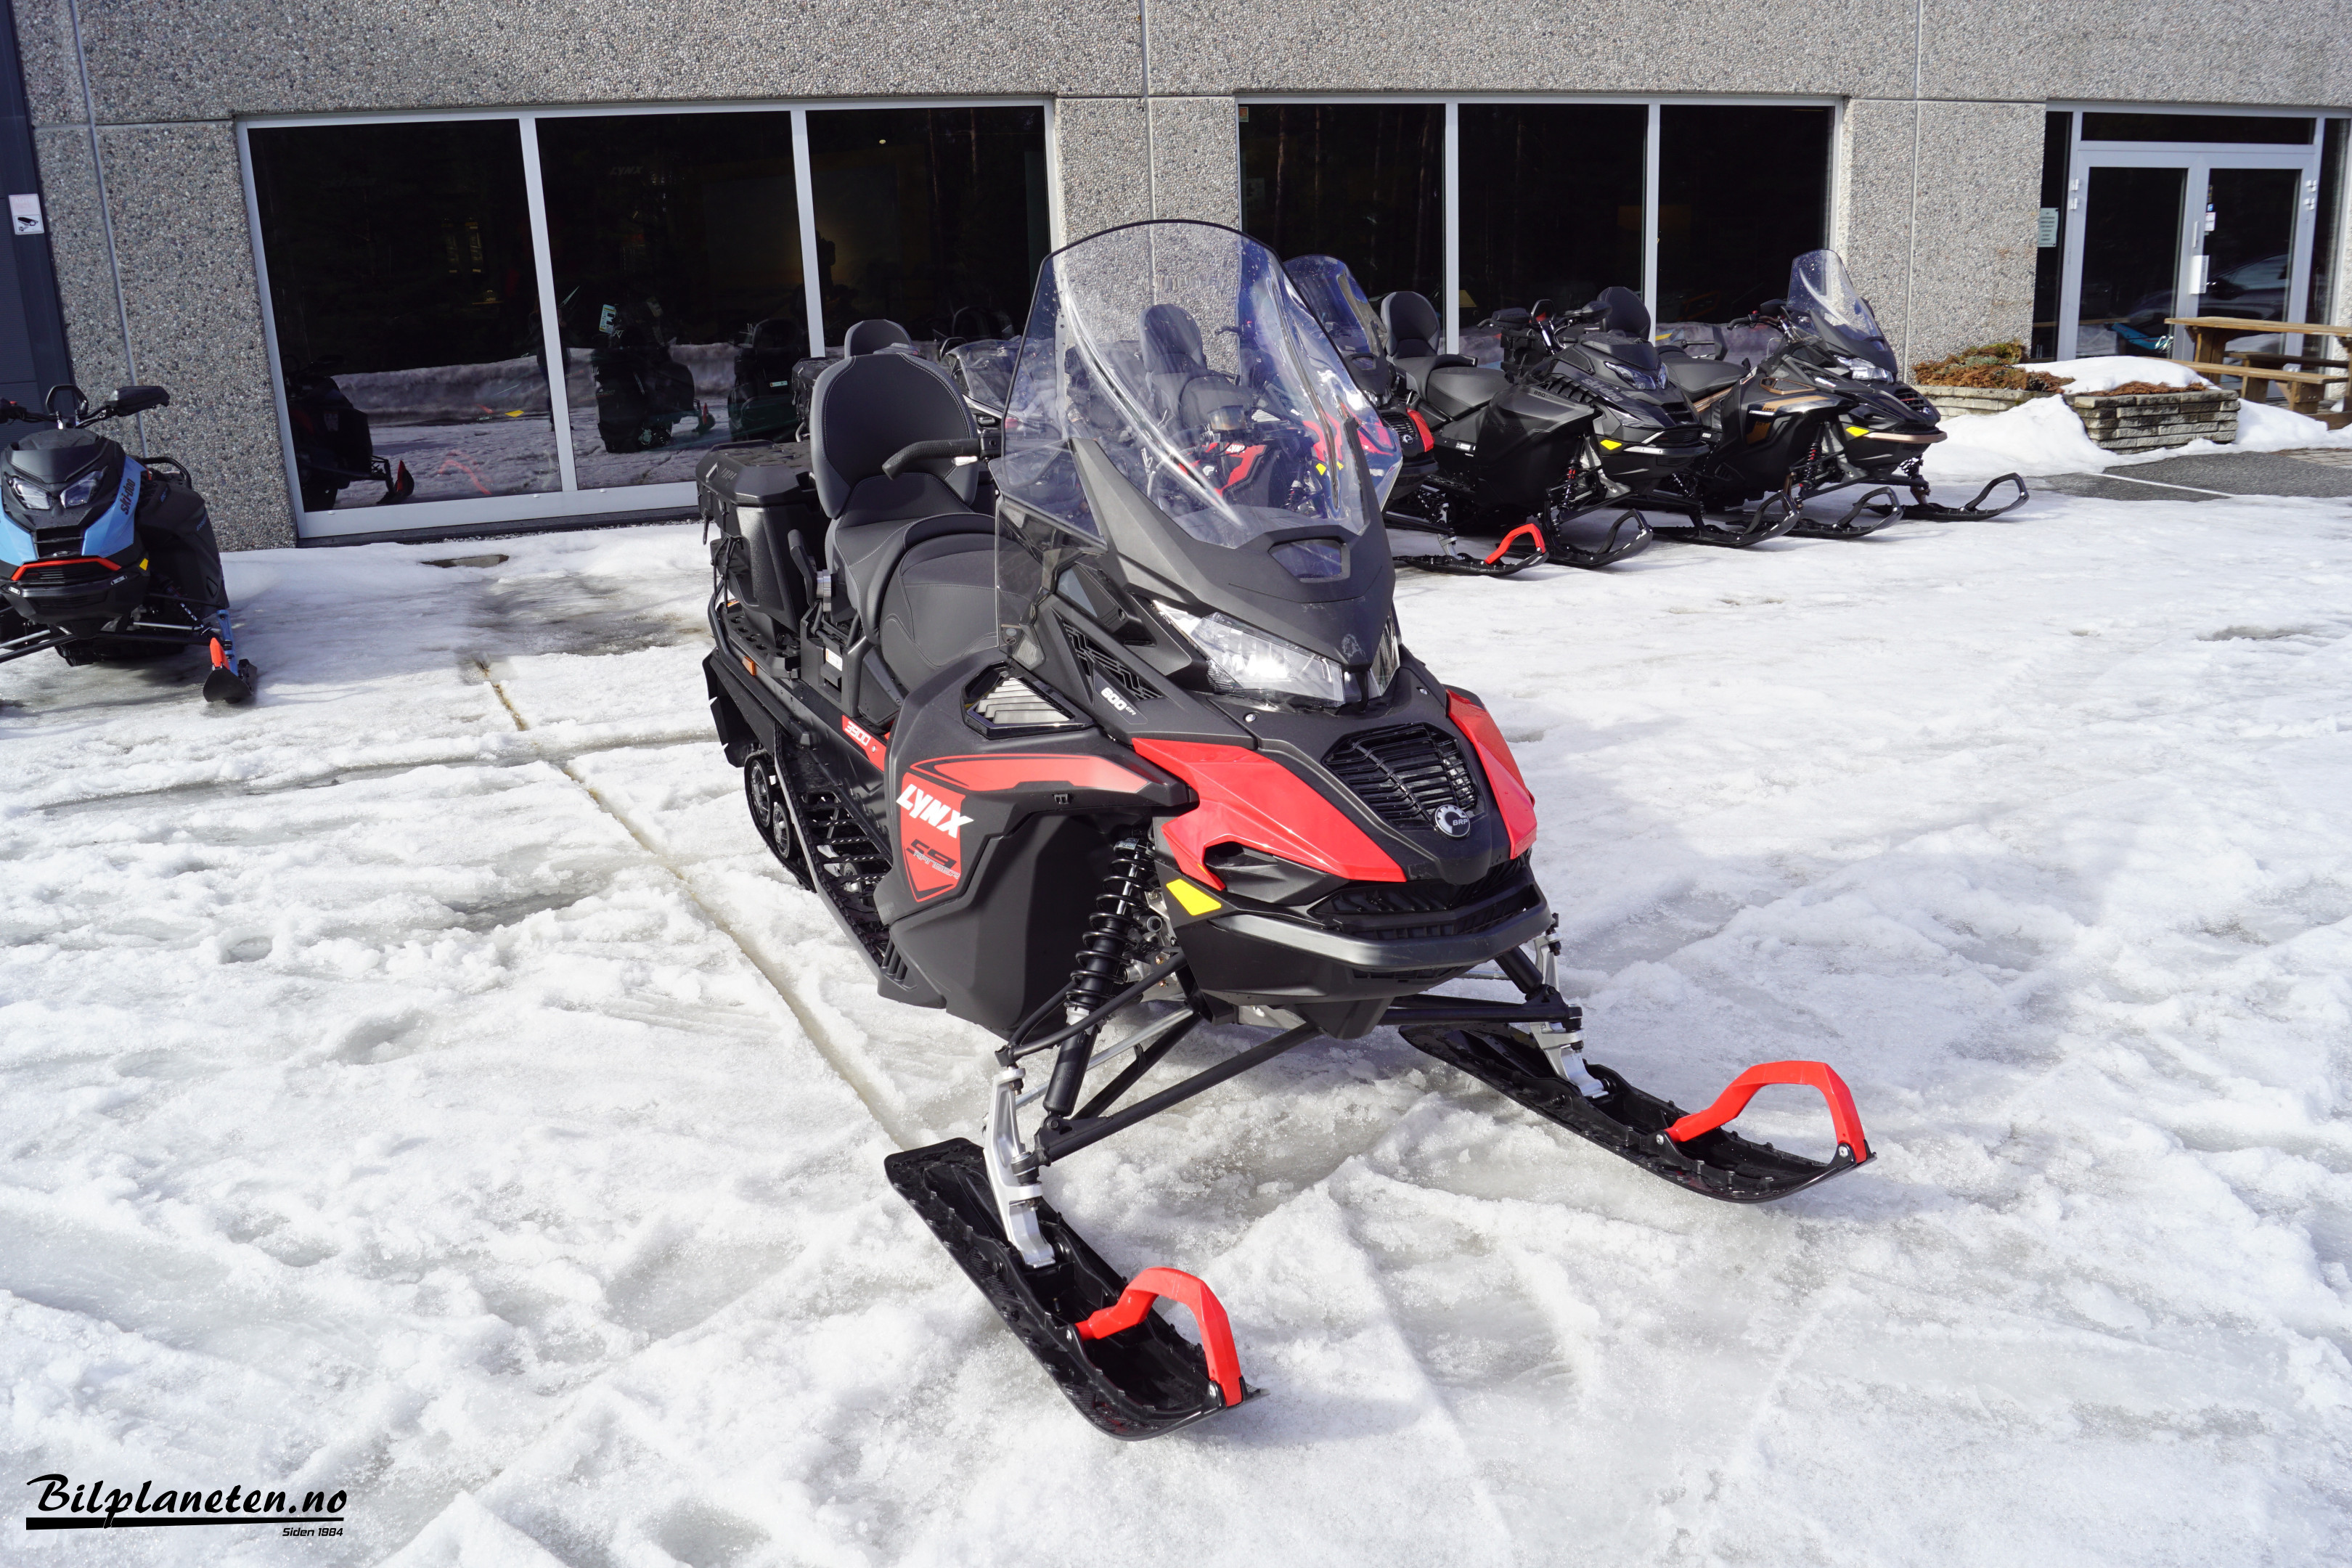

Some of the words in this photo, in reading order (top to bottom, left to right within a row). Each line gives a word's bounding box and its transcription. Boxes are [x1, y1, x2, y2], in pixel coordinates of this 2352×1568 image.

[1581, 378, 1624, 402] ski-doo
[120, 478, 136, 515] ski-doo
[1101, 687, 1127, 711] 600
[844, 721, 871, 747] 3900
[896, 783, 974, 839] LYNX
